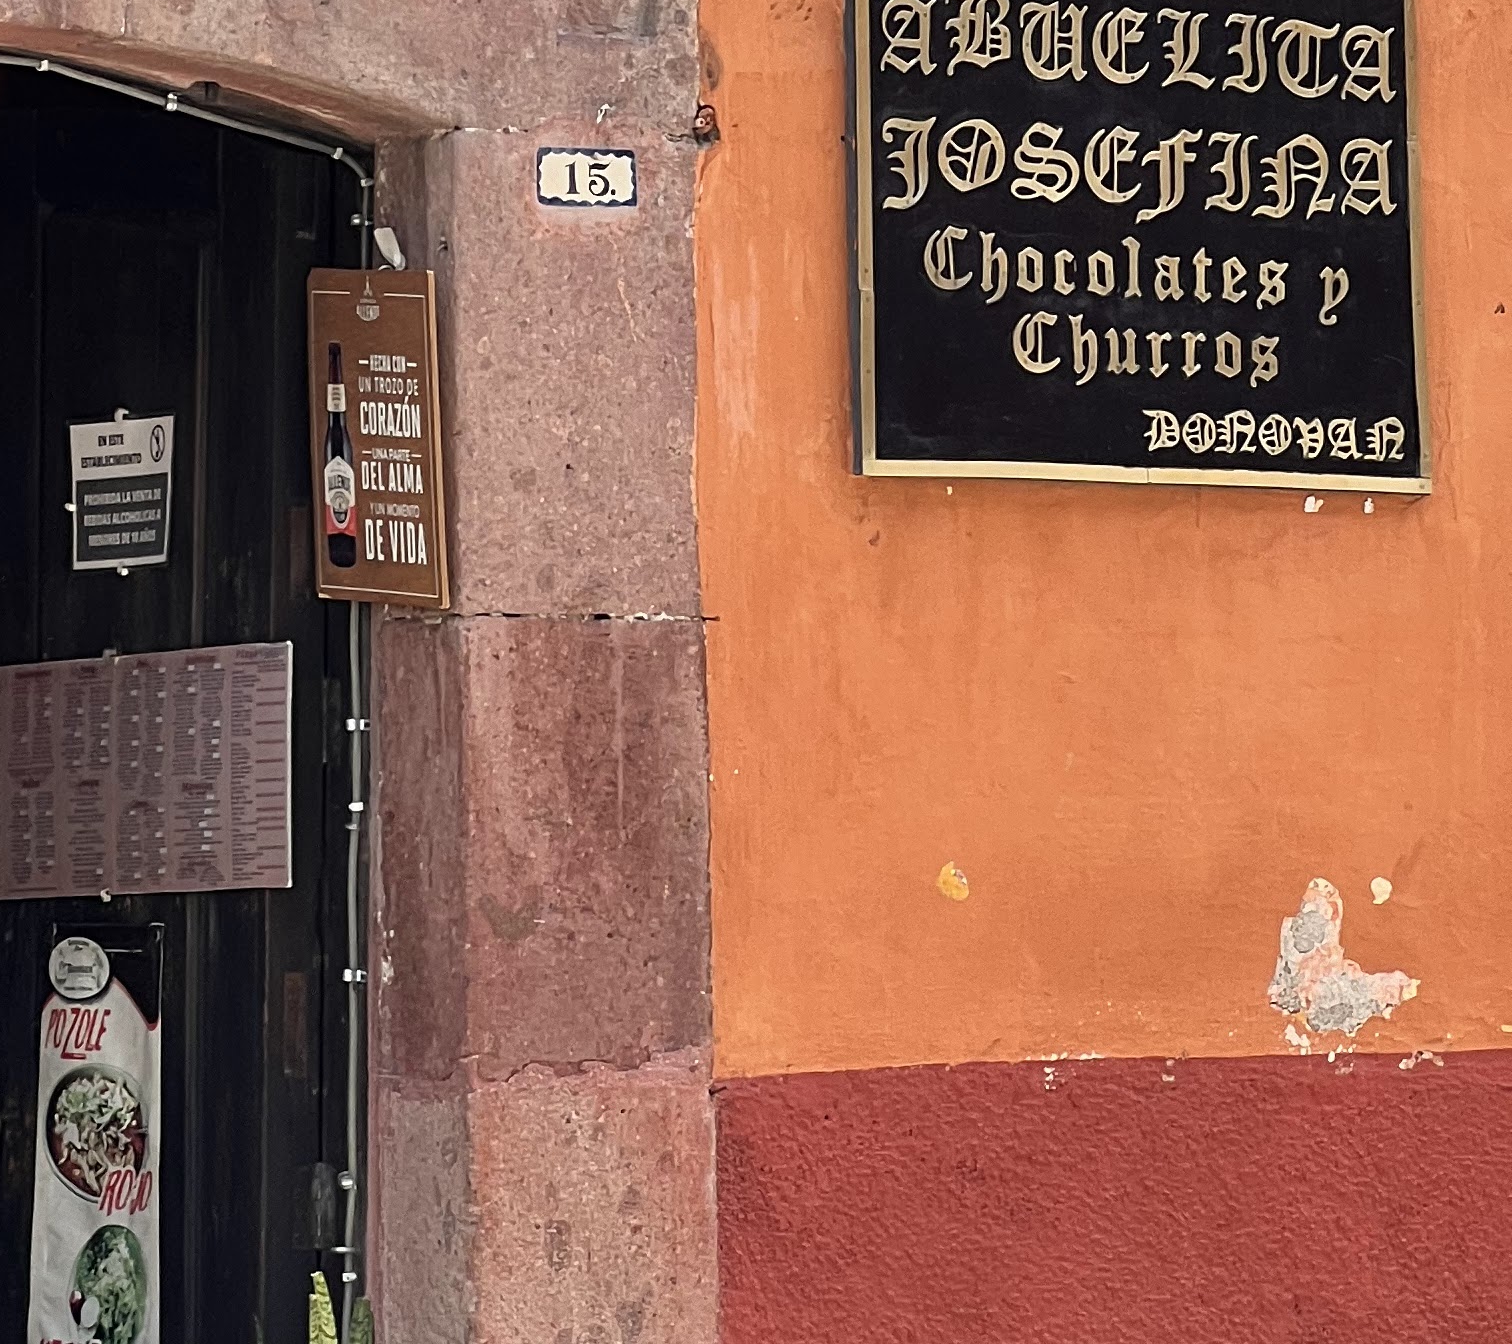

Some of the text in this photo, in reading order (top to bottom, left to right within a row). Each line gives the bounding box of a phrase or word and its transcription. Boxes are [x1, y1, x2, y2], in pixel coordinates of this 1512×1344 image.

[881, 116, 1399, 225] JOSEFINA
[923, 224, 1350, 326] Chocolates y
[1012, 310, 1281, 388] Churros
[358, 376, 419, 396] UN TROZO DE
[359, 395, 422, 439] CORAZÓN
[1142, 409, 1407, 463] DONOVAN
[361, 461, 385, 491] DEL
[388, 462, 424, 494] ALMA
[371, 447, 388, 460] UNA
[364, 518, 428, 566] DE VIDA
[44, 1008, 111, 1060] POZOLE
[98, 1169, 153, 1217] ROJO
